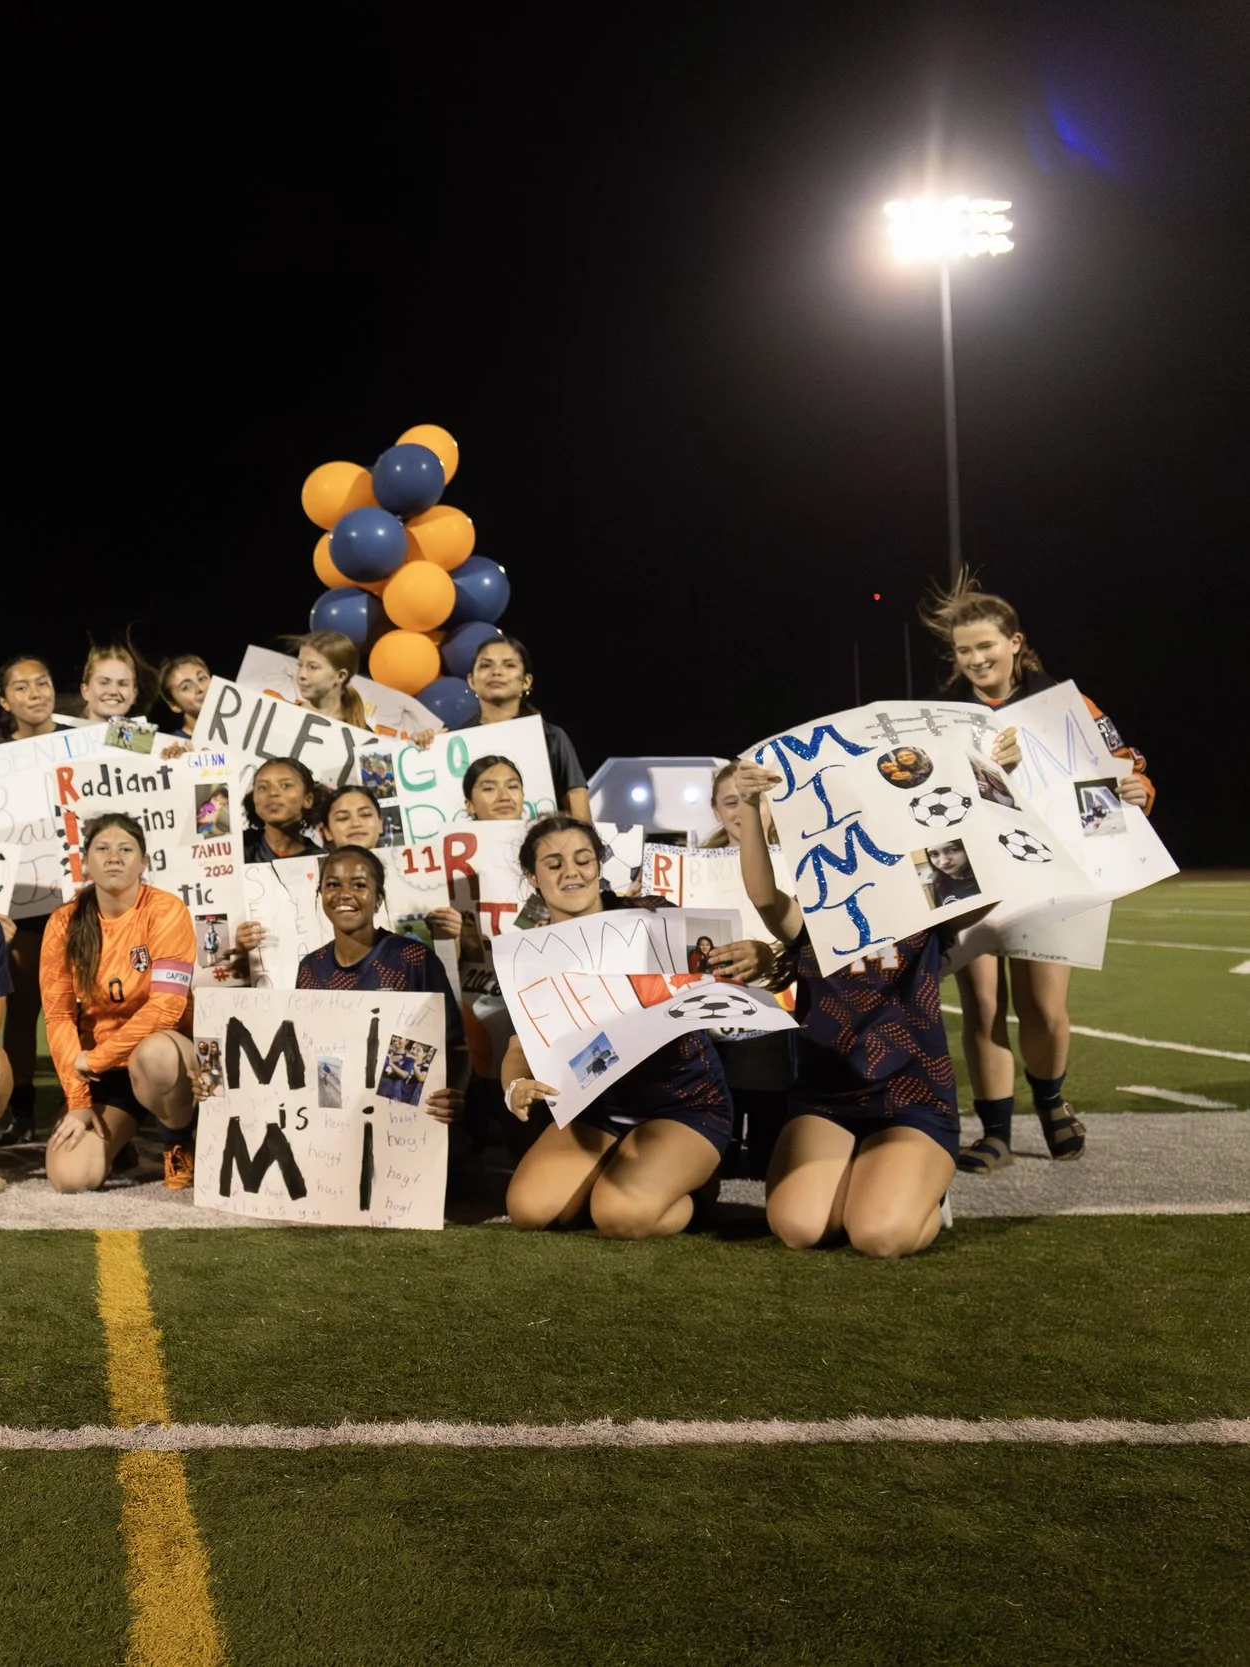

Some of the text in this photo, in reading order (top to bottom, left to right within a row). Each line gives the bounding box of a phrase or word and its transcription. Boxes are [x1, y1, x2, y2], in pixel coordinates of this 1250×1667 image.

[56, 764, 173, 806] Radiant
[204, 864, 234, 879] 2030
[402, 846, 441, 875] 11
[513, 917, 676, 982] MIMI
[279, 1103, 308, 1130] is
